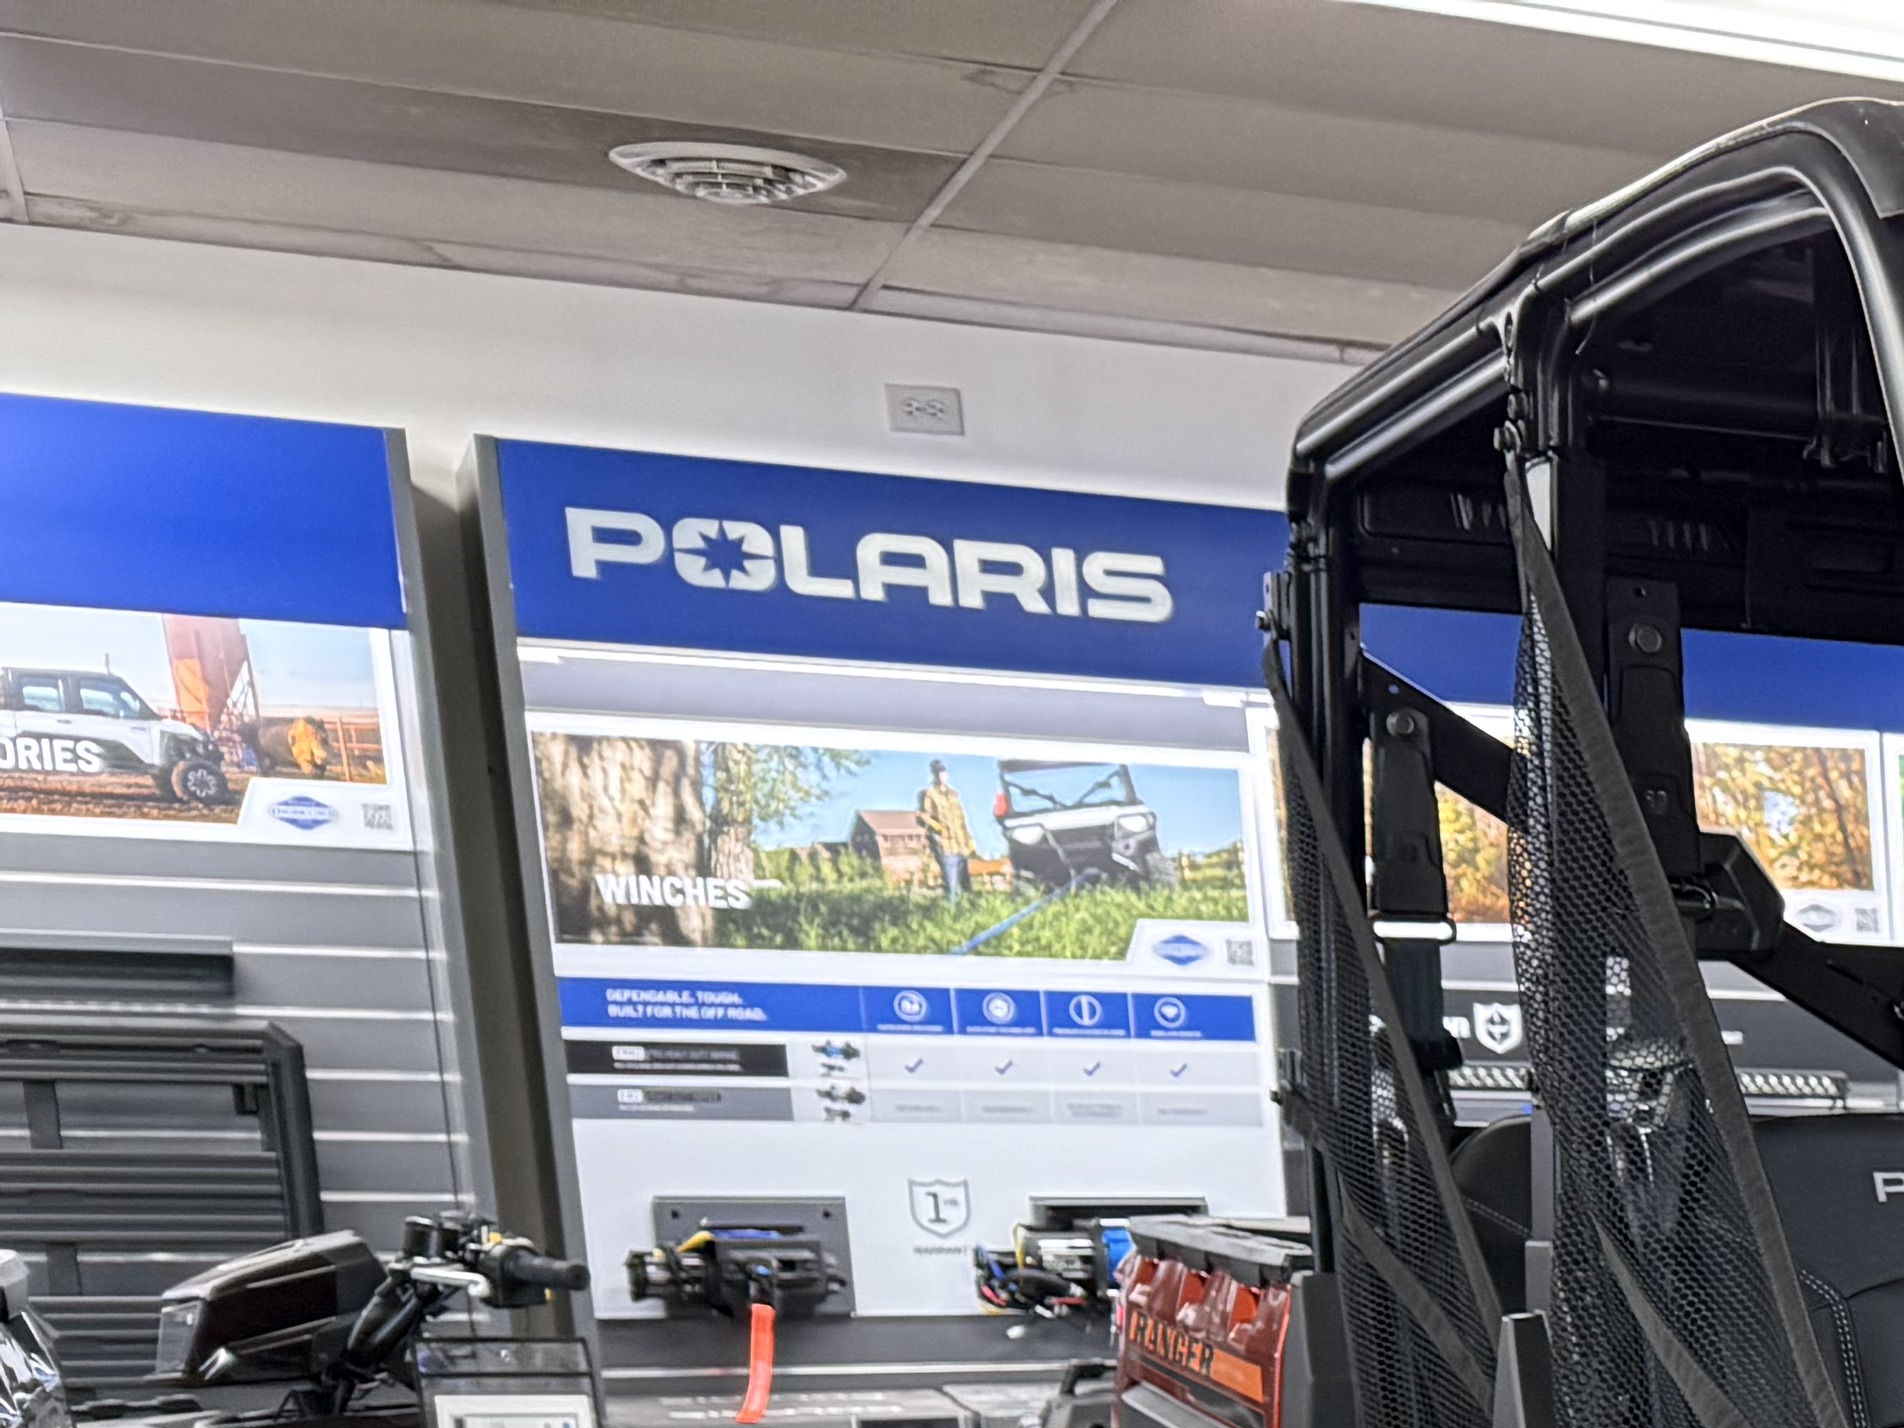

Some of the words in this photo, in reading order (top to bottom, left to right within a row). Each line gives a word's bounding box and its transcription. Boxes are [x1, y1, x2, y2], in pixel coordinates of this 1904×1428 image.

[564, 506, 1174, 623] POLARIS
[595, 874, 754, 910] WINCHES
[1129, 1309, 1216, 1378] RANGER
